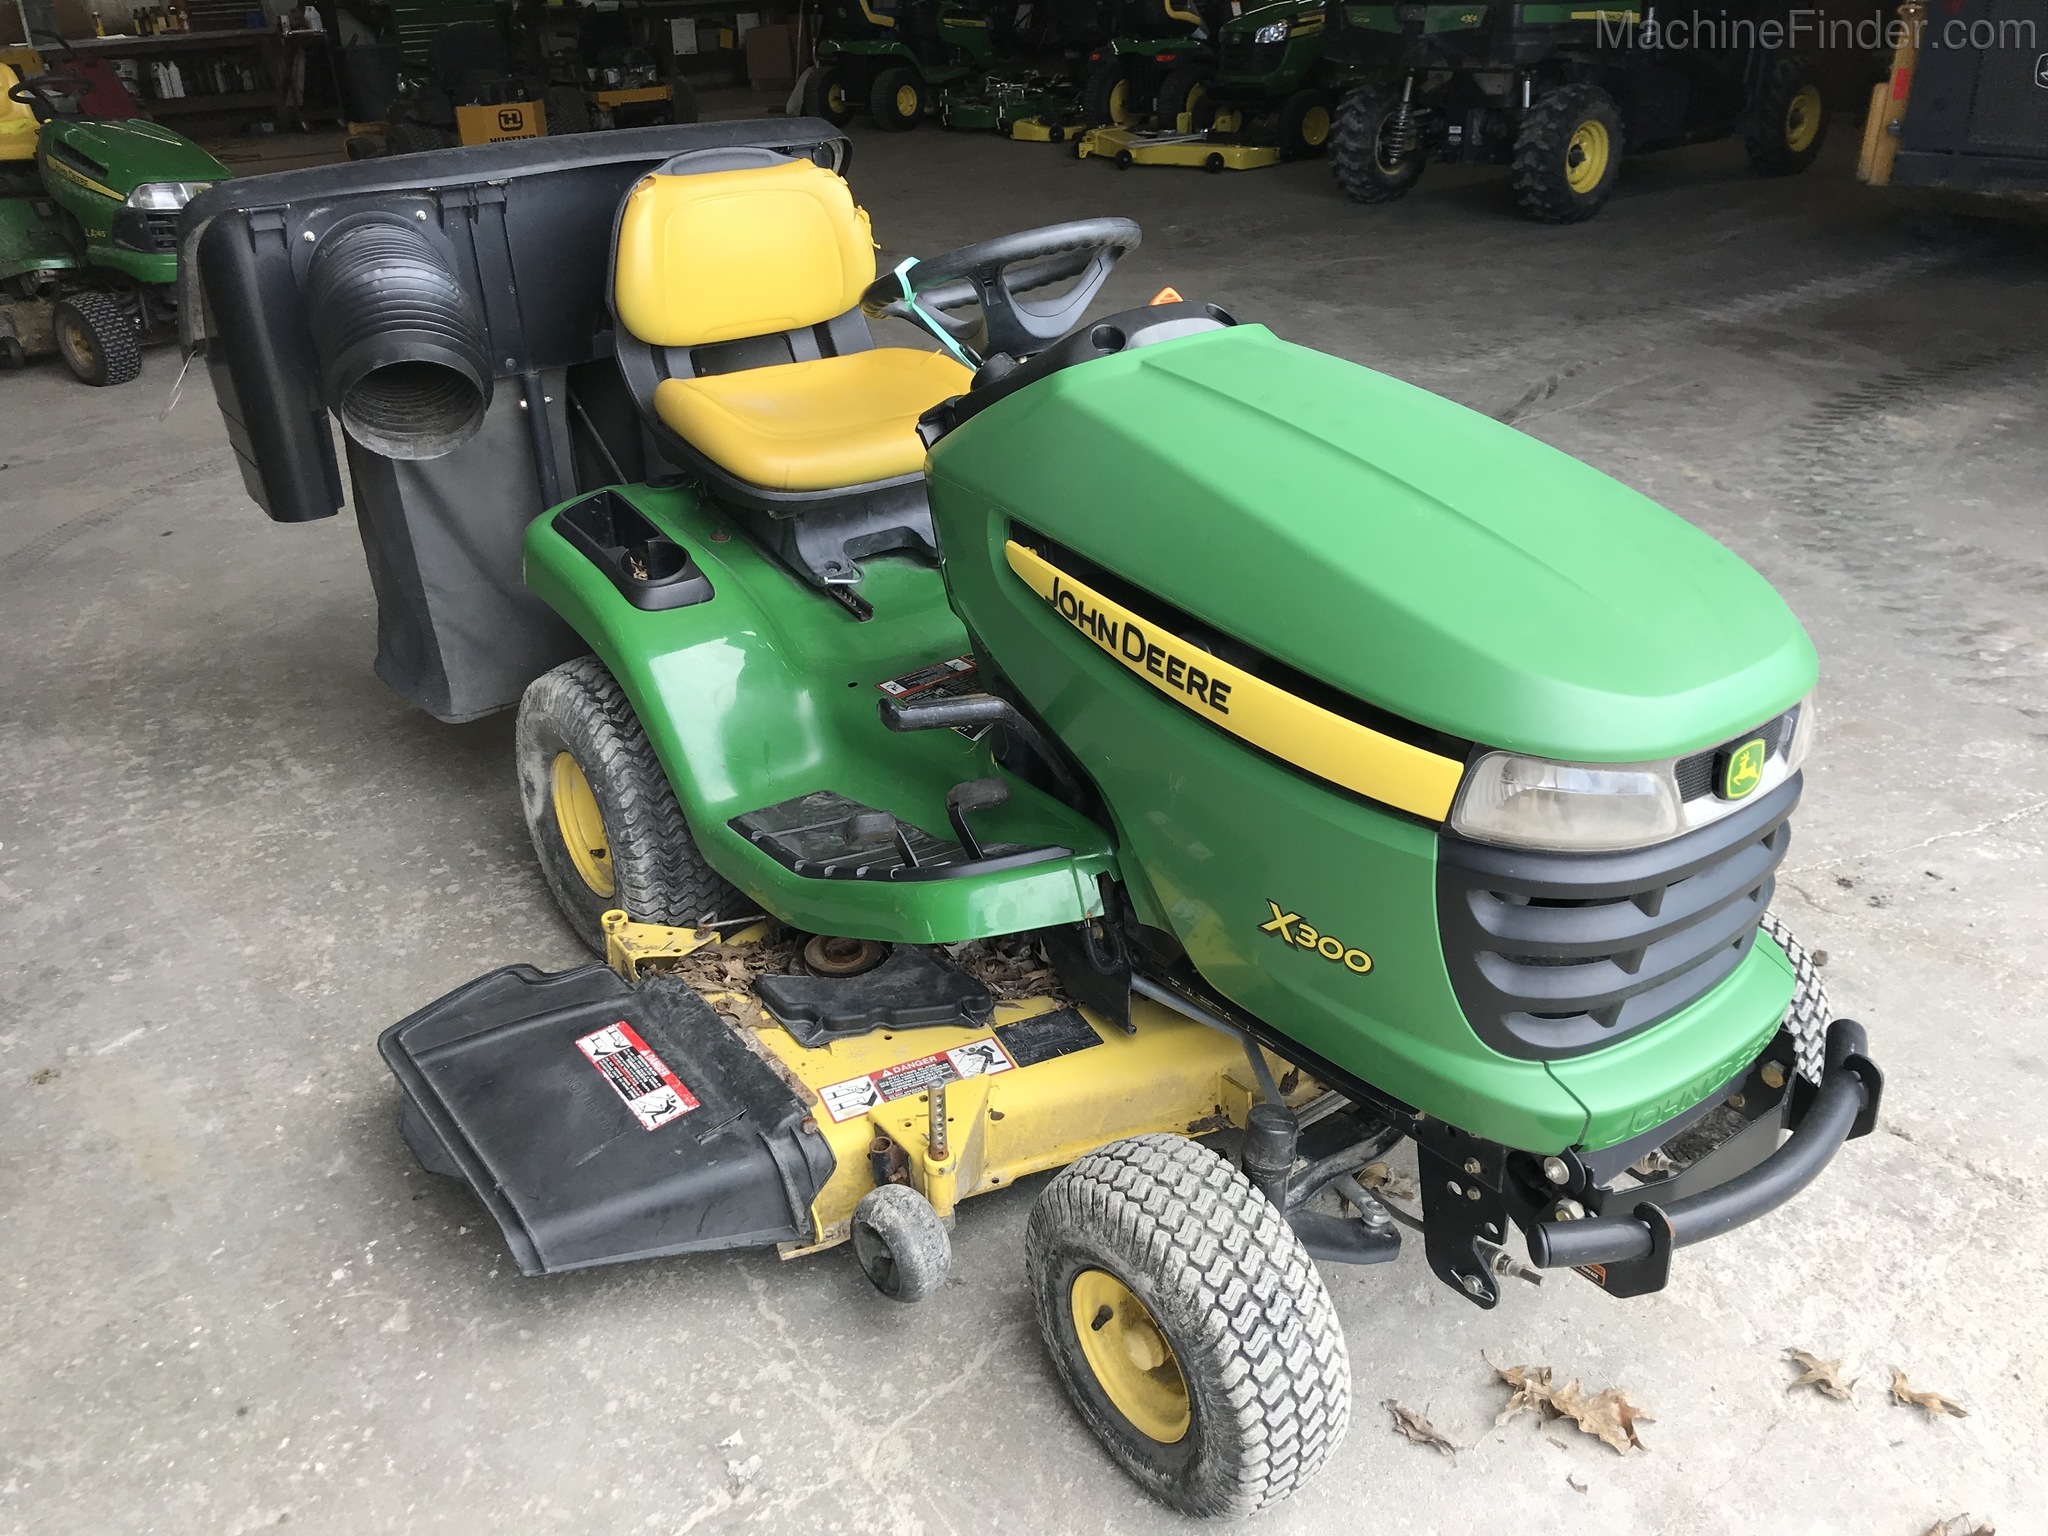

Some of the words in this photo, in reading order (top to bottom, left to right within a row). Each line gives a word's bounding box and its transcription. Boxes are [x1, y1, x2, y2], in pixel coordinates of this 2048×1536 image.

[1044, 577, 1118, 651] JOHN
[1122, 621, 1233, 715] DEERE
[1257, 898, 1375, 976] X300
[645, 1054, 671, 1077] DANGER
[892, 1055, 938, 1075] DANGER
[1605, 1079, 1711, 1144] JOHN
